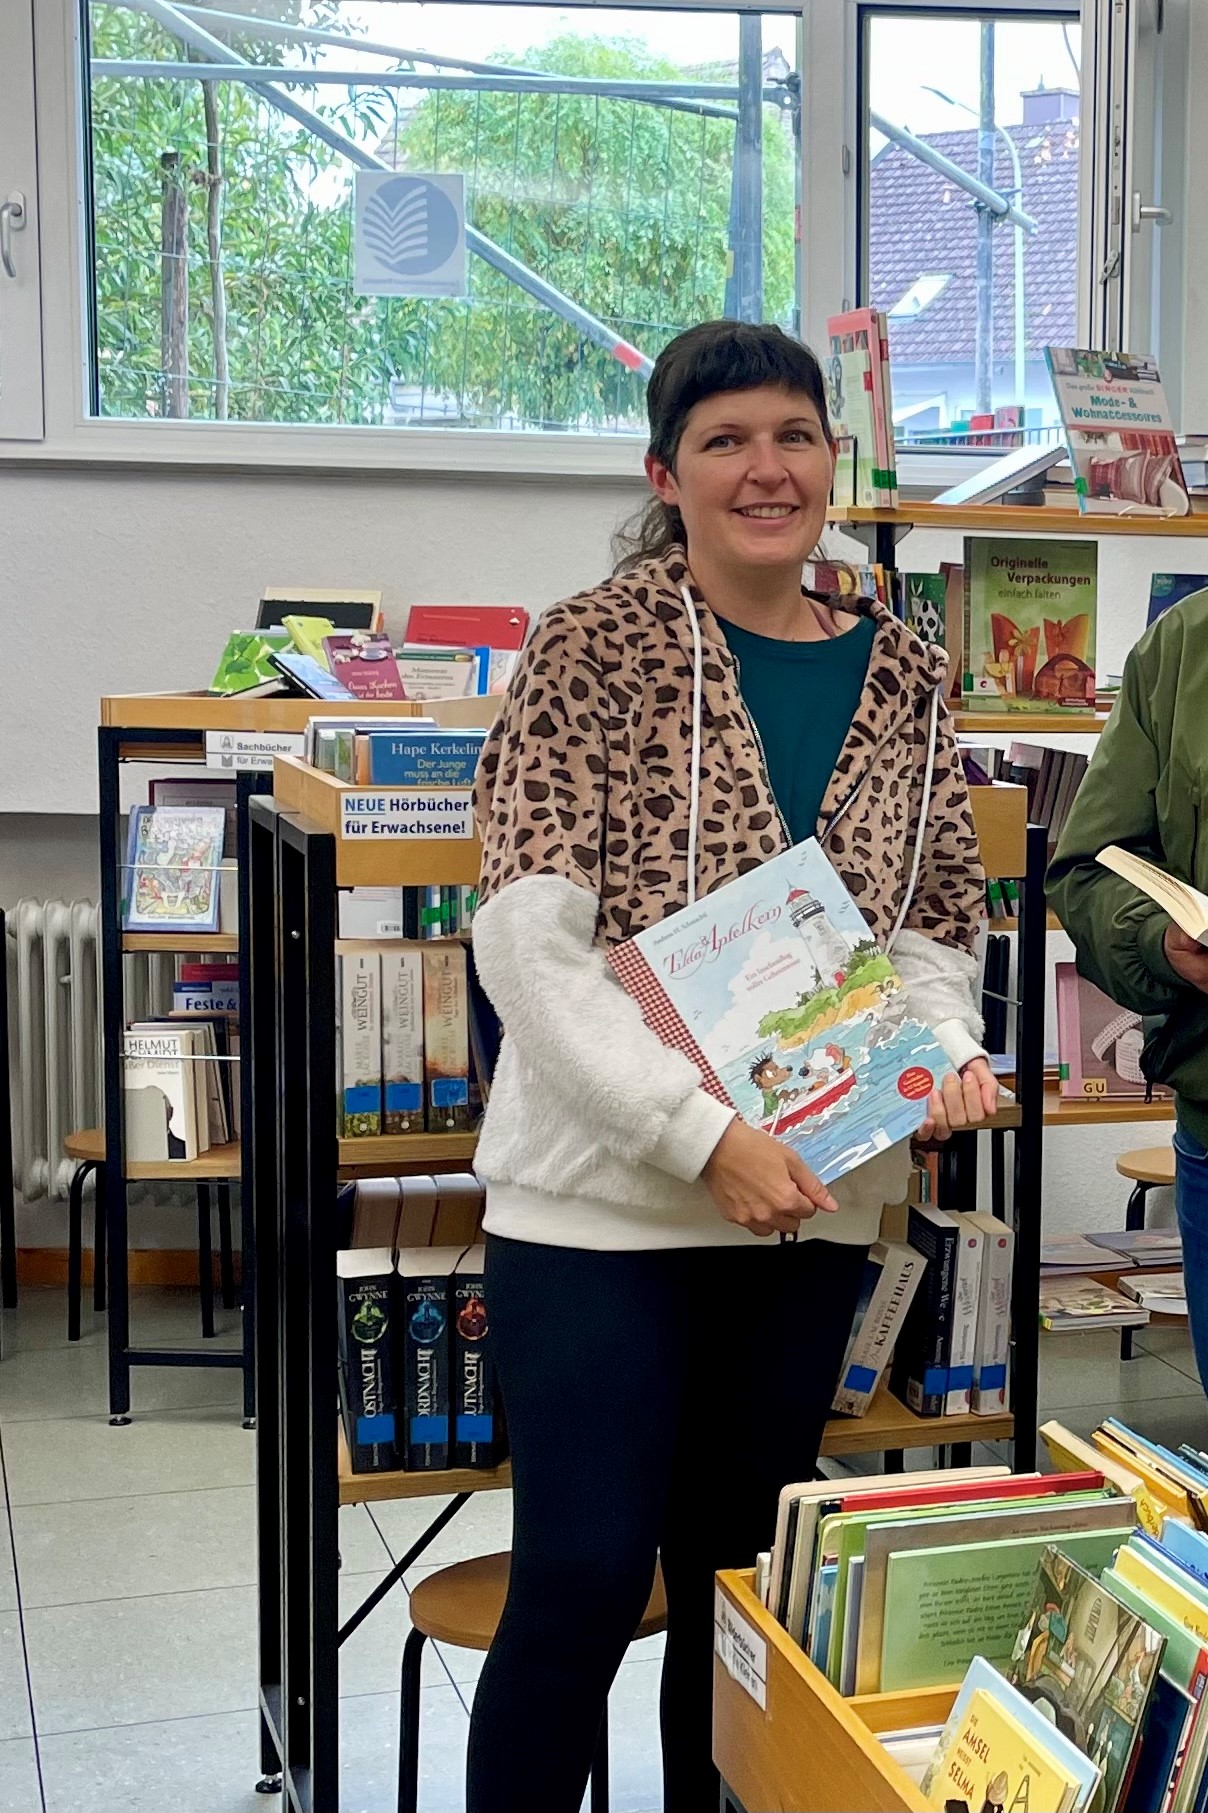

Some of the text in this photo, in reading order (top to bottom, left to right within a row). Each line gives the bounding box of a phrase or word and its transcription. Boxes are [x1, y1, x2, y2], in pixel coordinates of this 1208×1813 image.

[1090, 395, 1138, 408] Mode- &
[1072, 407, 1162, 423] Wohnaccessoires
[991, 556, 1048, 571] Originelle
[1007, 571, 1091, 587] Verpackungen
[998, 588, 1062, 599] einfach falten
[237, 743, 293, 752] Sachbücher
[391, 743, 427, 758] Hape
[236, 756, 248, 765] für
[417, 759, 467, 772] Der Junge
[404, 771, 429, 779] muss
[445, 770, 460, 778] die
[344, 798, 469, 811] NEUE Hörbücher
[345, 820, 465, 834] für Erwachsene!
[186, 997, 238, 1011] Feste &
[357, 974, 368, 1031] WEINGUT
[399, 972, 409, 1029] WEINGUT
[442, 971, 453, 1028] WEINGUT
[129, 1039, 178, 1050] HELMUT
[147, 1059, 179, 1070] Dienst
[349, 1291, 388, 1302] GWYNNE
[407, 1292, 447, 1302] GWYNNE
[875, 1261, 915, 1347] KAFFEEHAUS
[463, 1350, 482, 1416] UTNACHT
[970, 1715, 979, 1727] DIE
[962, 1728, 990, 1764] AMSEL
[948, 1761, 975, 1800] SELMA
